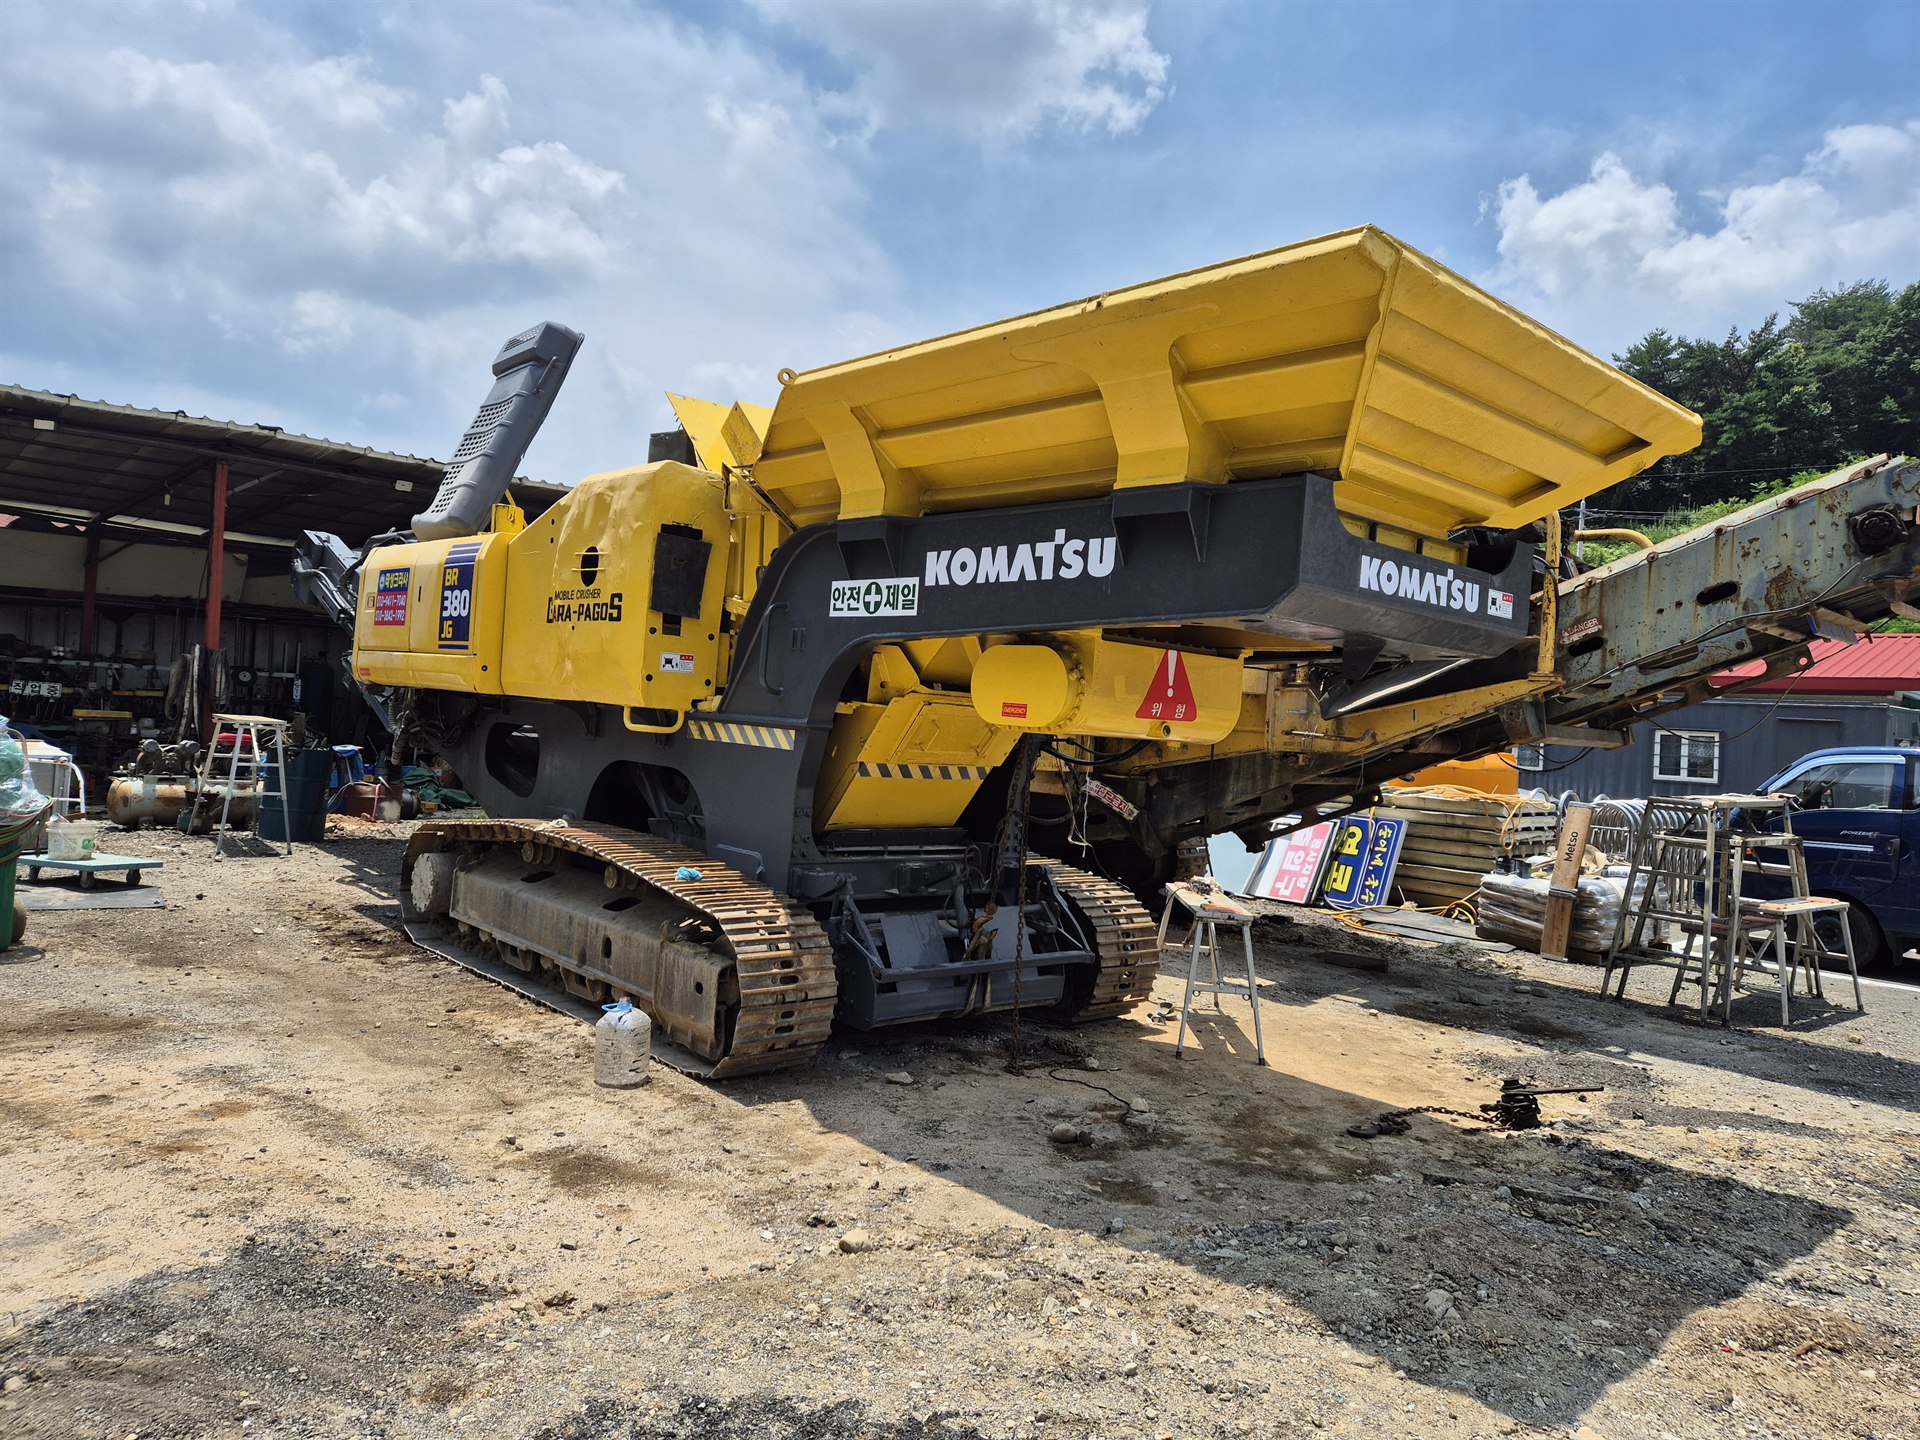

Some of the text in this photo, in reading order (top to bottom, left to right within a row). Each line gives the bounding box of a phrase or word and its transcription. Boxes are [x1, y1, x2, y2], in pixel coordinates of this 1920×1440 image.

[925, 529, 1116, 587] KOMATSU
[445, 567, 459, 586] BR
[1359, 554, 1480, 613] KOMATSU
[442, 589, 470, 617] 380
[554, 588, 602, 600] MOBILE CRUSHER
[831, 583, 916, 612] 안전 제일
[441, 620, 453, 638] JG
[1568, 617, 1599, 635] DANGER
[1563, 831, 1579, 862] Metso
